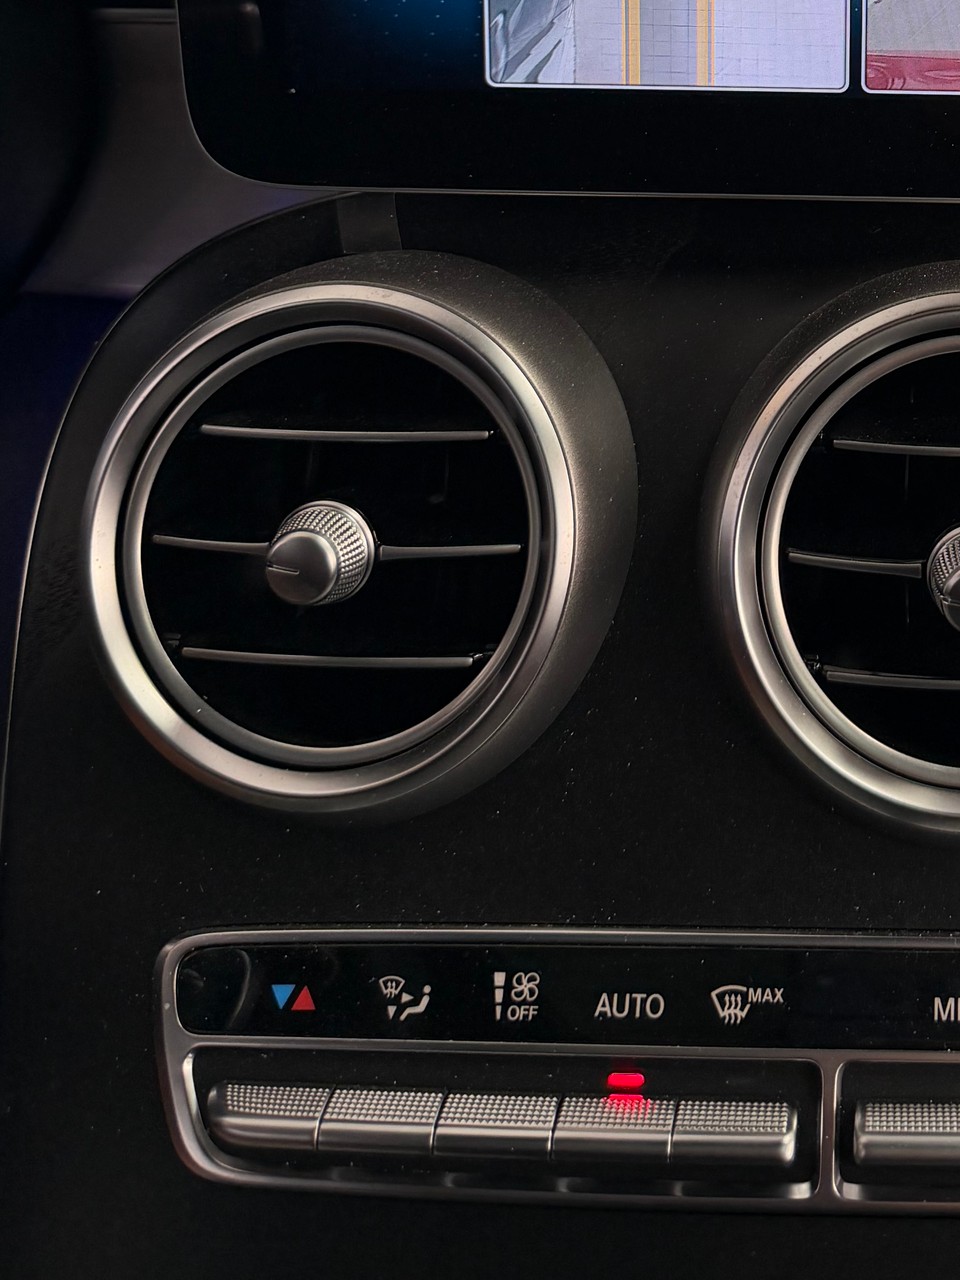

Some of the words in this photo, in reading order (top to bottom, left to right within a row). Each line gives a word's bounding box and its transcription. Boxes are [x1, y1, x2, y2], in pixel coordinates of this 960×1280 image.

[747, 987, 784, 1003] MAX
[507, 1005, 539, 1021] OFF
[593, 992, 666, 1019] AUTO
